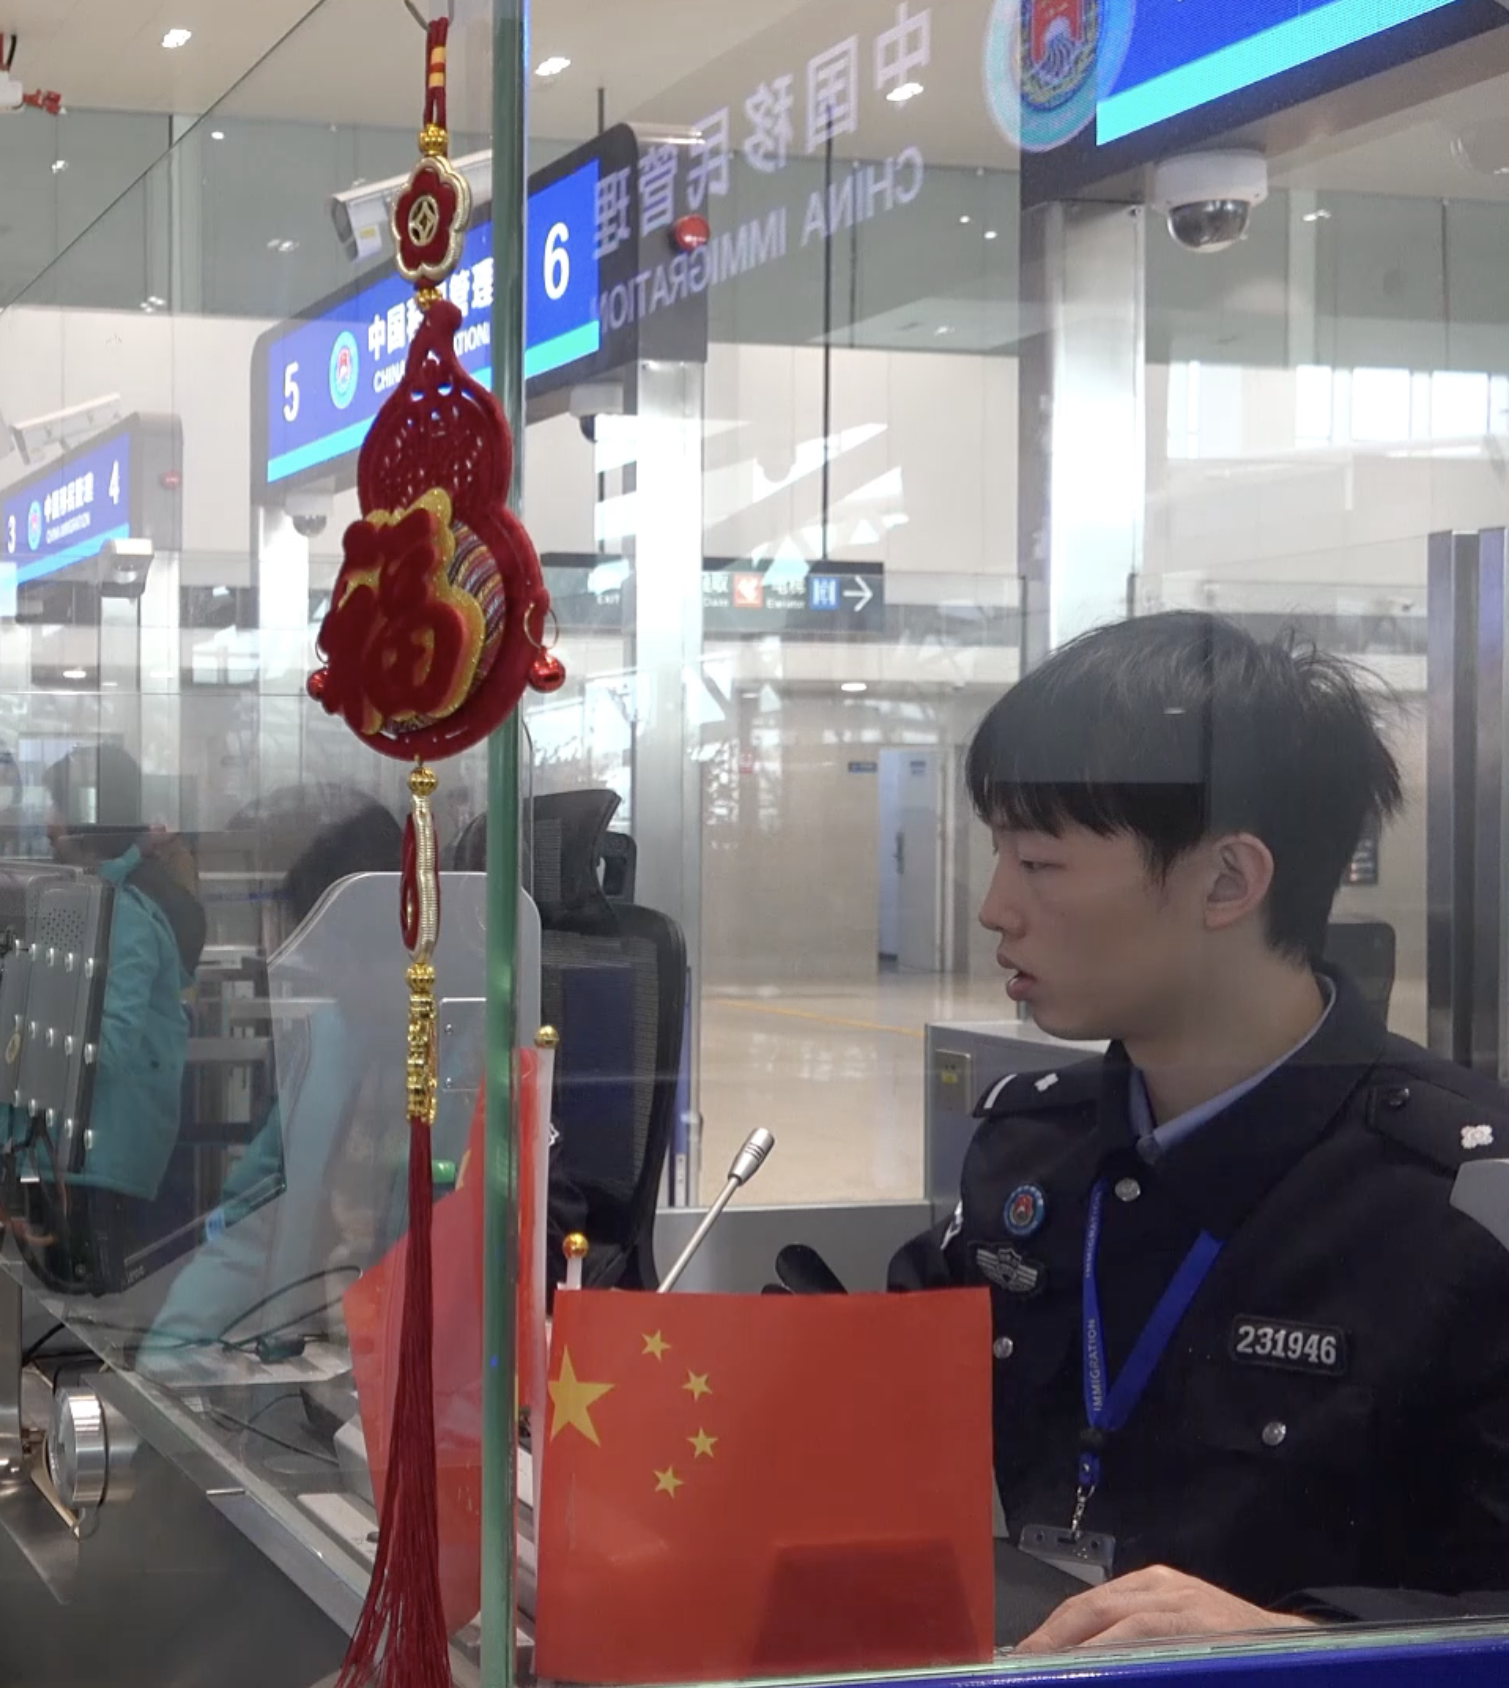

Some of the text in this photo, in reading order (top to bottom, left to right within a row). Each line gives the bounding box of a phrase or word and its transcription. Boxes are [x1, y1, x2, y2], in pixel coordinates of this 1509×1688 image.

[543, 221, 570, 300] 6
[282, 361, 300, 422] 5
[108, 460, 120, 505] 4
[7, 514, 17, 554] 3
[1087, 1318, 1103, 1412] IMMIGRATION
[1235, 1324, 1338, 1366] 231946
